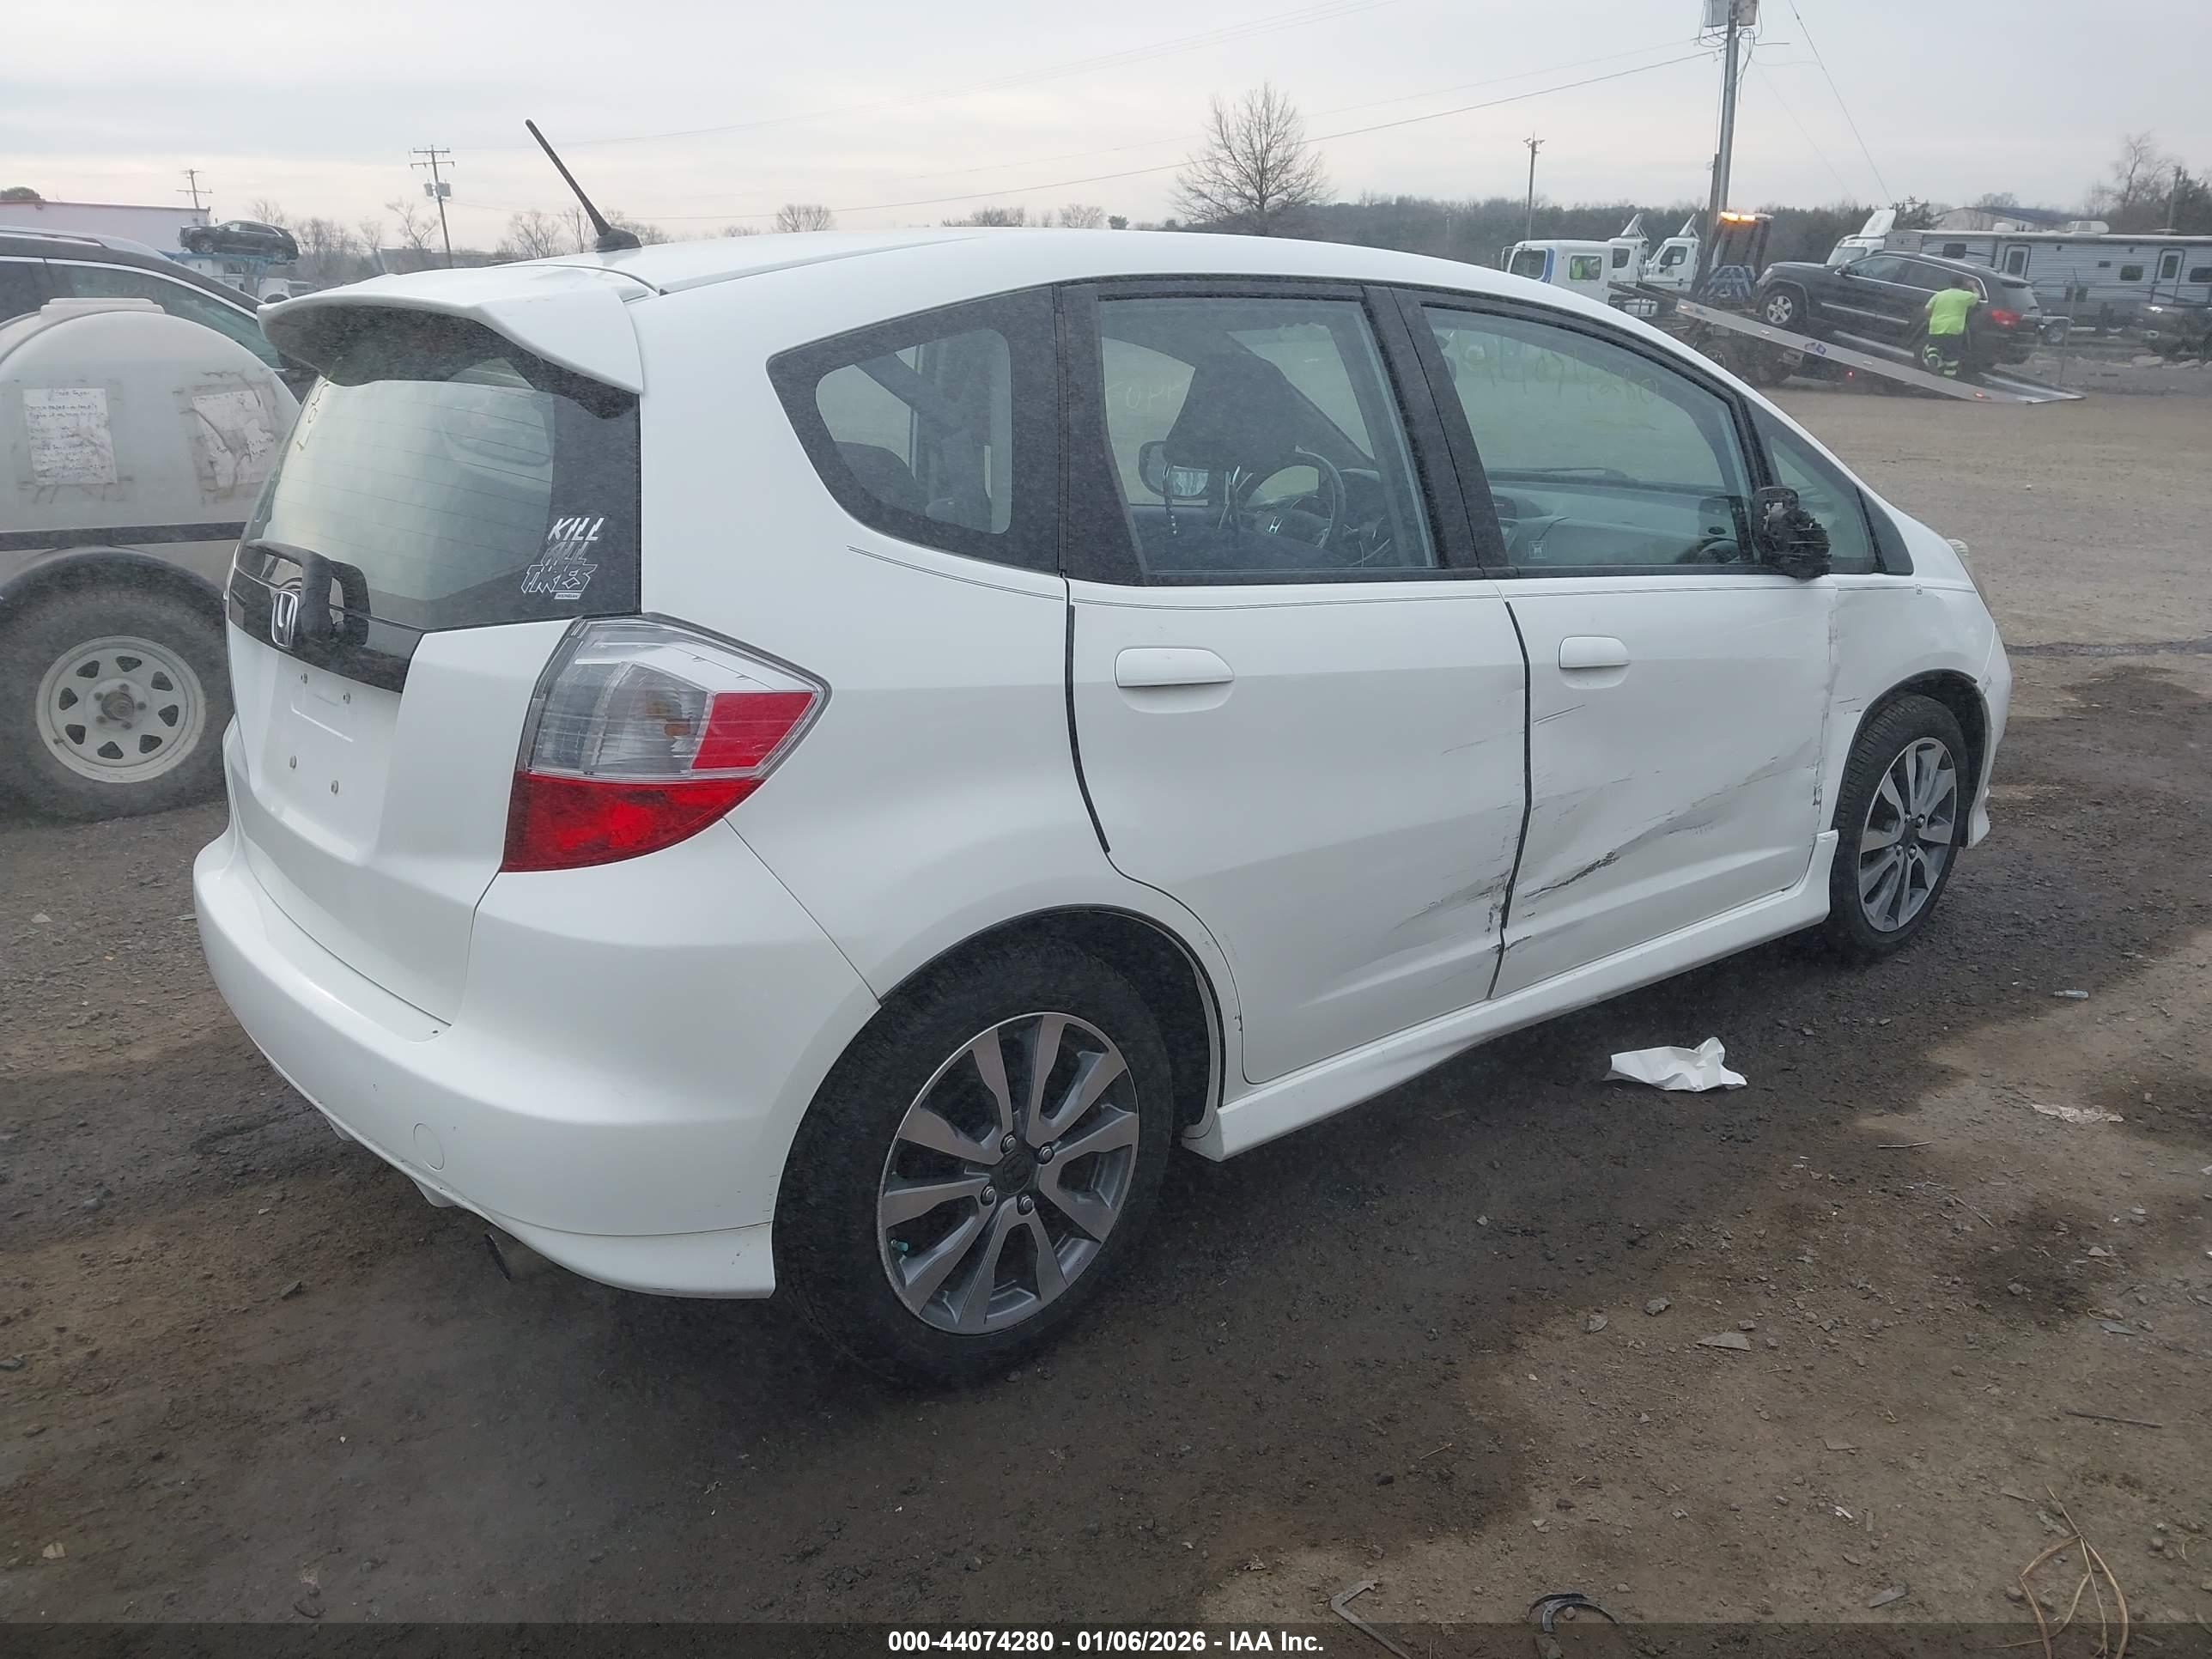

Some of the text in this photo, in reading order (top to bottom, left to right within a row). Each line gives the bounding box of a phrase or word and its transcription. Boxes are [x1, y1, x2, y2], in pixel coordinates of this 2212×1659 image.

[547, 516, 605, 541] KILL
[541, 541, 588, 566] ALL
[520, 563, 599, 593] TIRES
